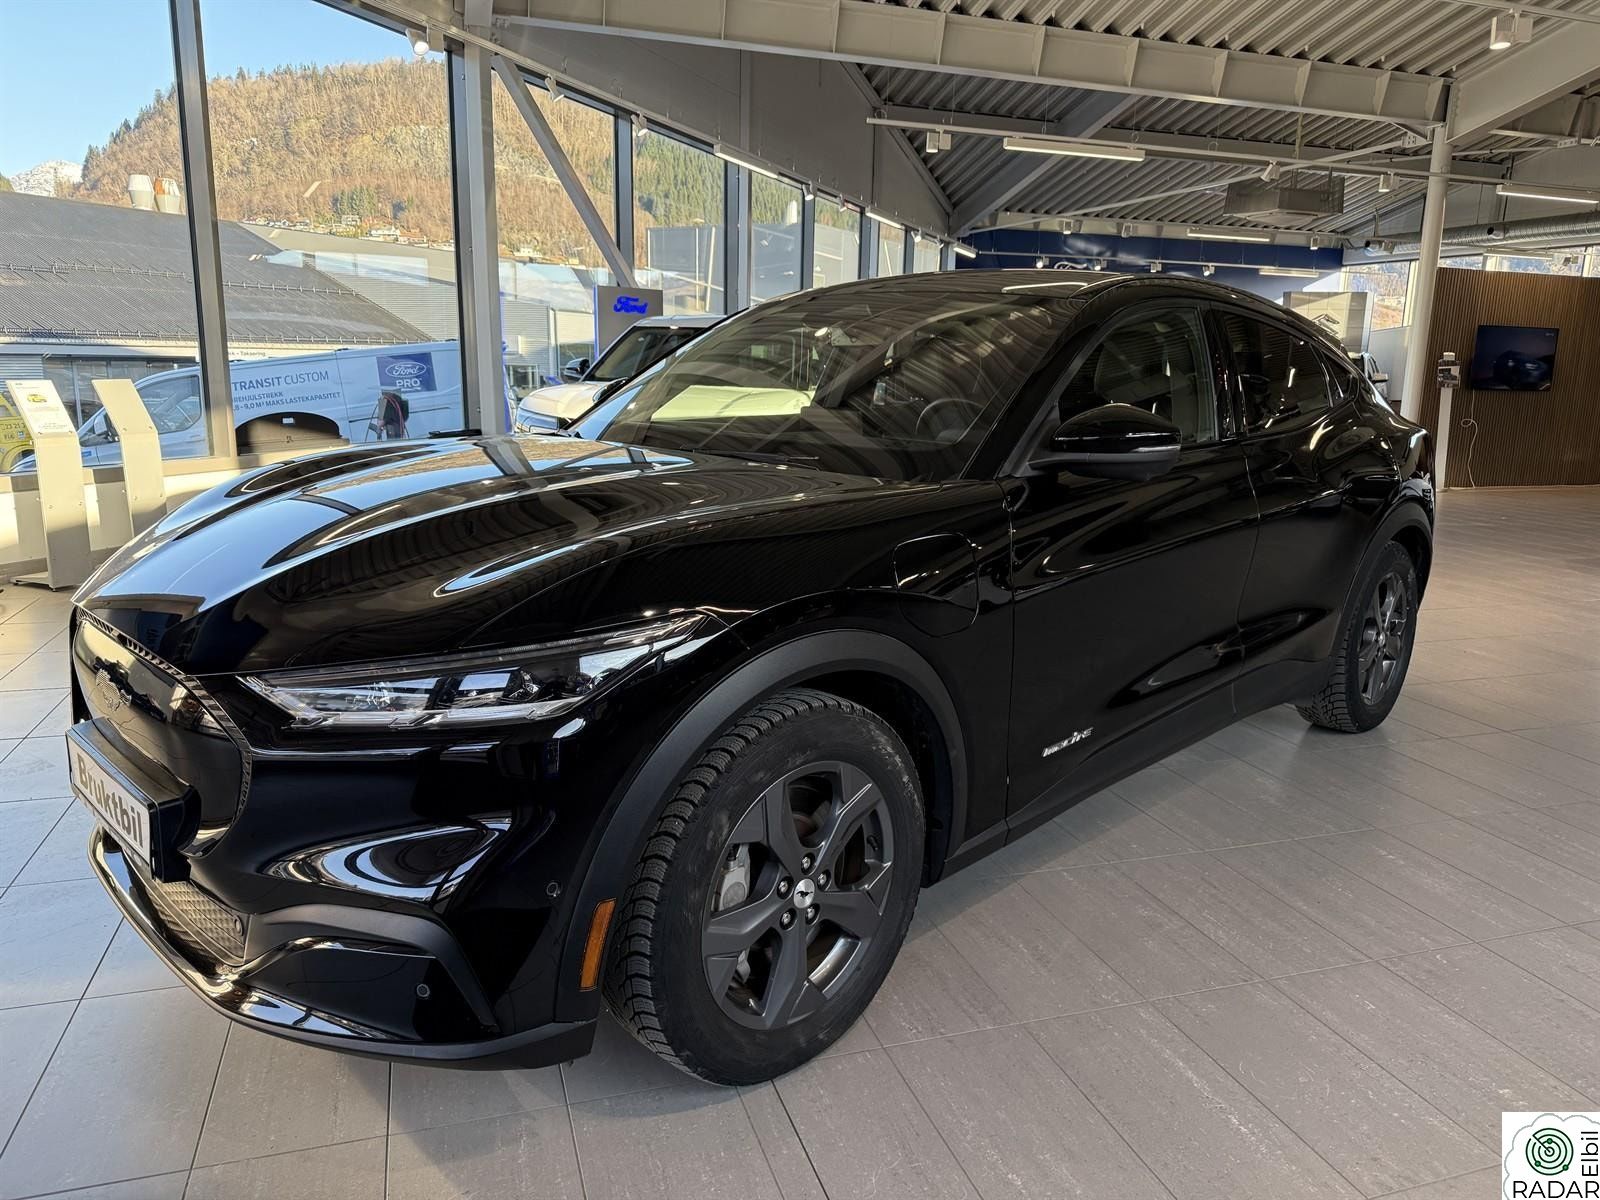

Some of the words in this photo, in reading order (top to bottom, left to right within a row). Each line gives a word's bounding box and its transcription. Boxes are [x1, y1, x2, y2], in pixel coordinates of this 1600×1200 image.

[613, 296, 648, 315] Ford
[392, 365, 420, 375] Ford
[232, 376, 282, 391] TRANSIT
[284, 370, 329, 385] CUSTOM
[396, 378, 420, 388] PRO
[265, 398, 285, 407] MAKS
[285, 391, 341, 404] LASTEKAPASITET
[76, 750, 144, 849] Bruktbil
